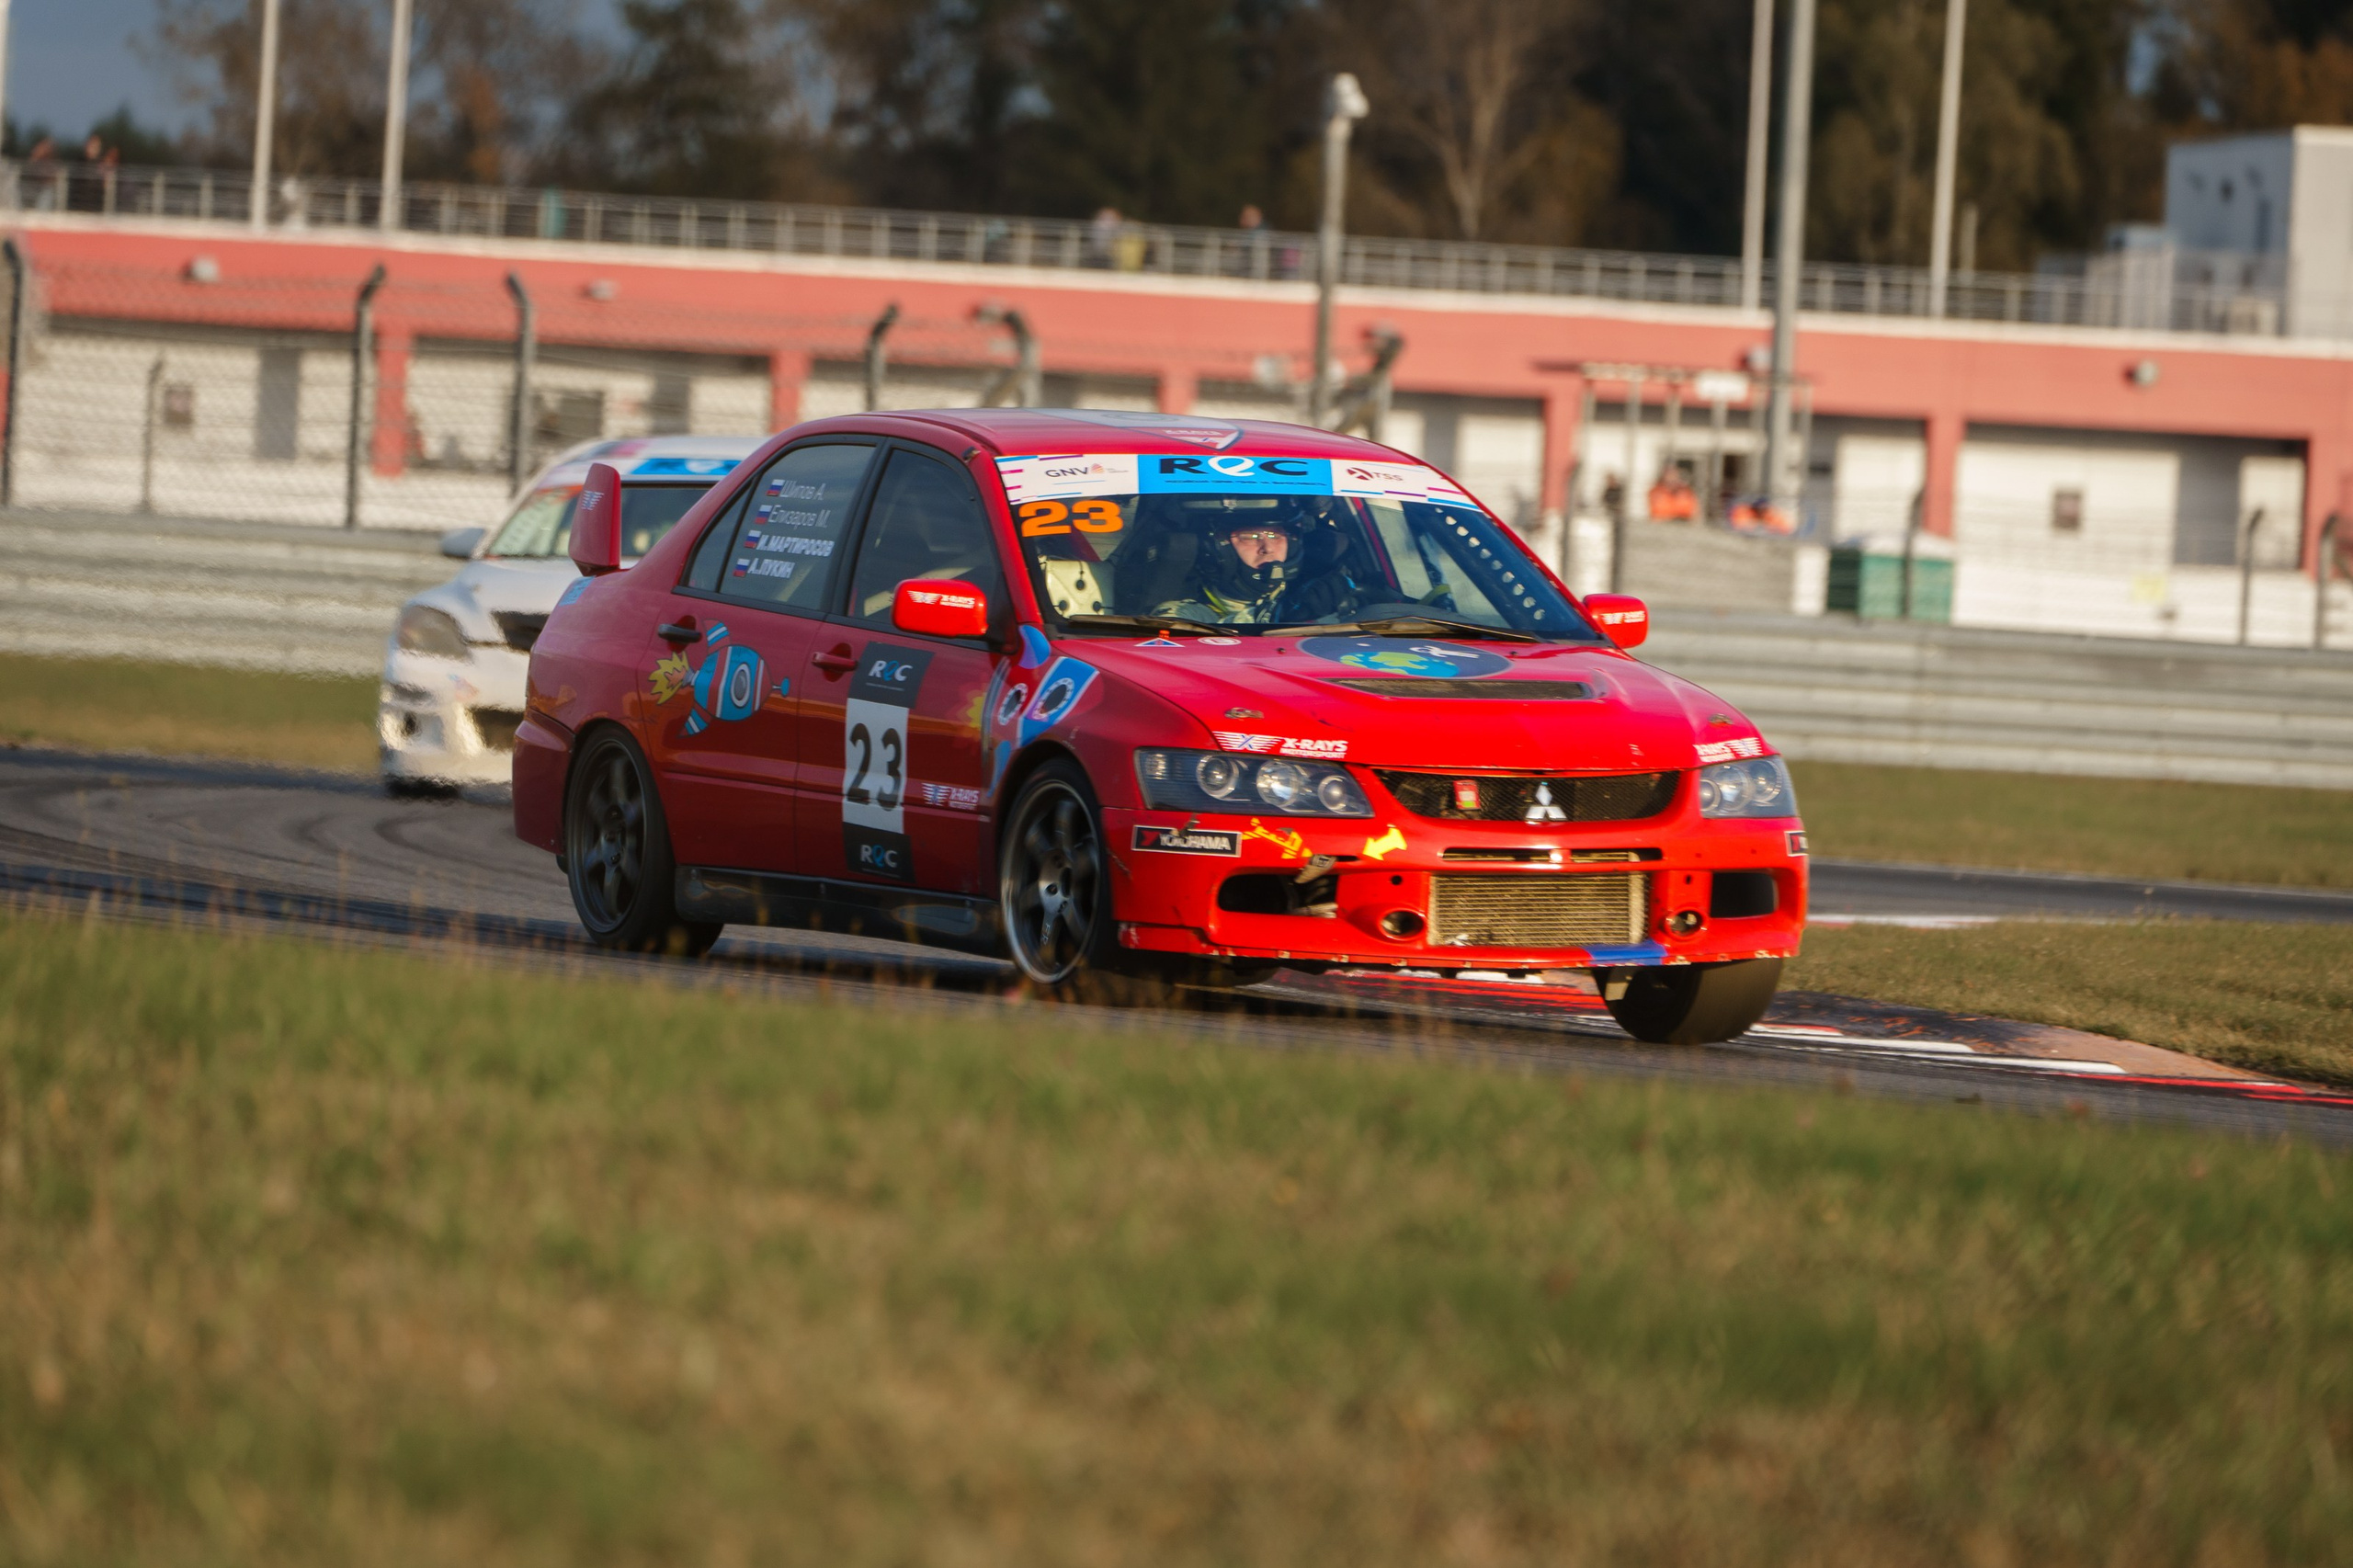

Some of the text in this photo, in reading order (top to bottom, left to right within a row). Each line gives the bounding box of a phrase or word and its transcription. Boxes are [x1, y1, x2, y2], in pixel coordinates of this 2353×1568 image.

[1045, 467, 1089, 478] GNV
[1373, 472, 1404, 482] TSS
[779, 480, 816, 500] Шипов
[768, 505, 817, 530] Елизаров
[1018, 500, 1124, 537] 23
[1283, 737, 1348, 752] X-RAYS
[847, 722, 902, 812] 23
